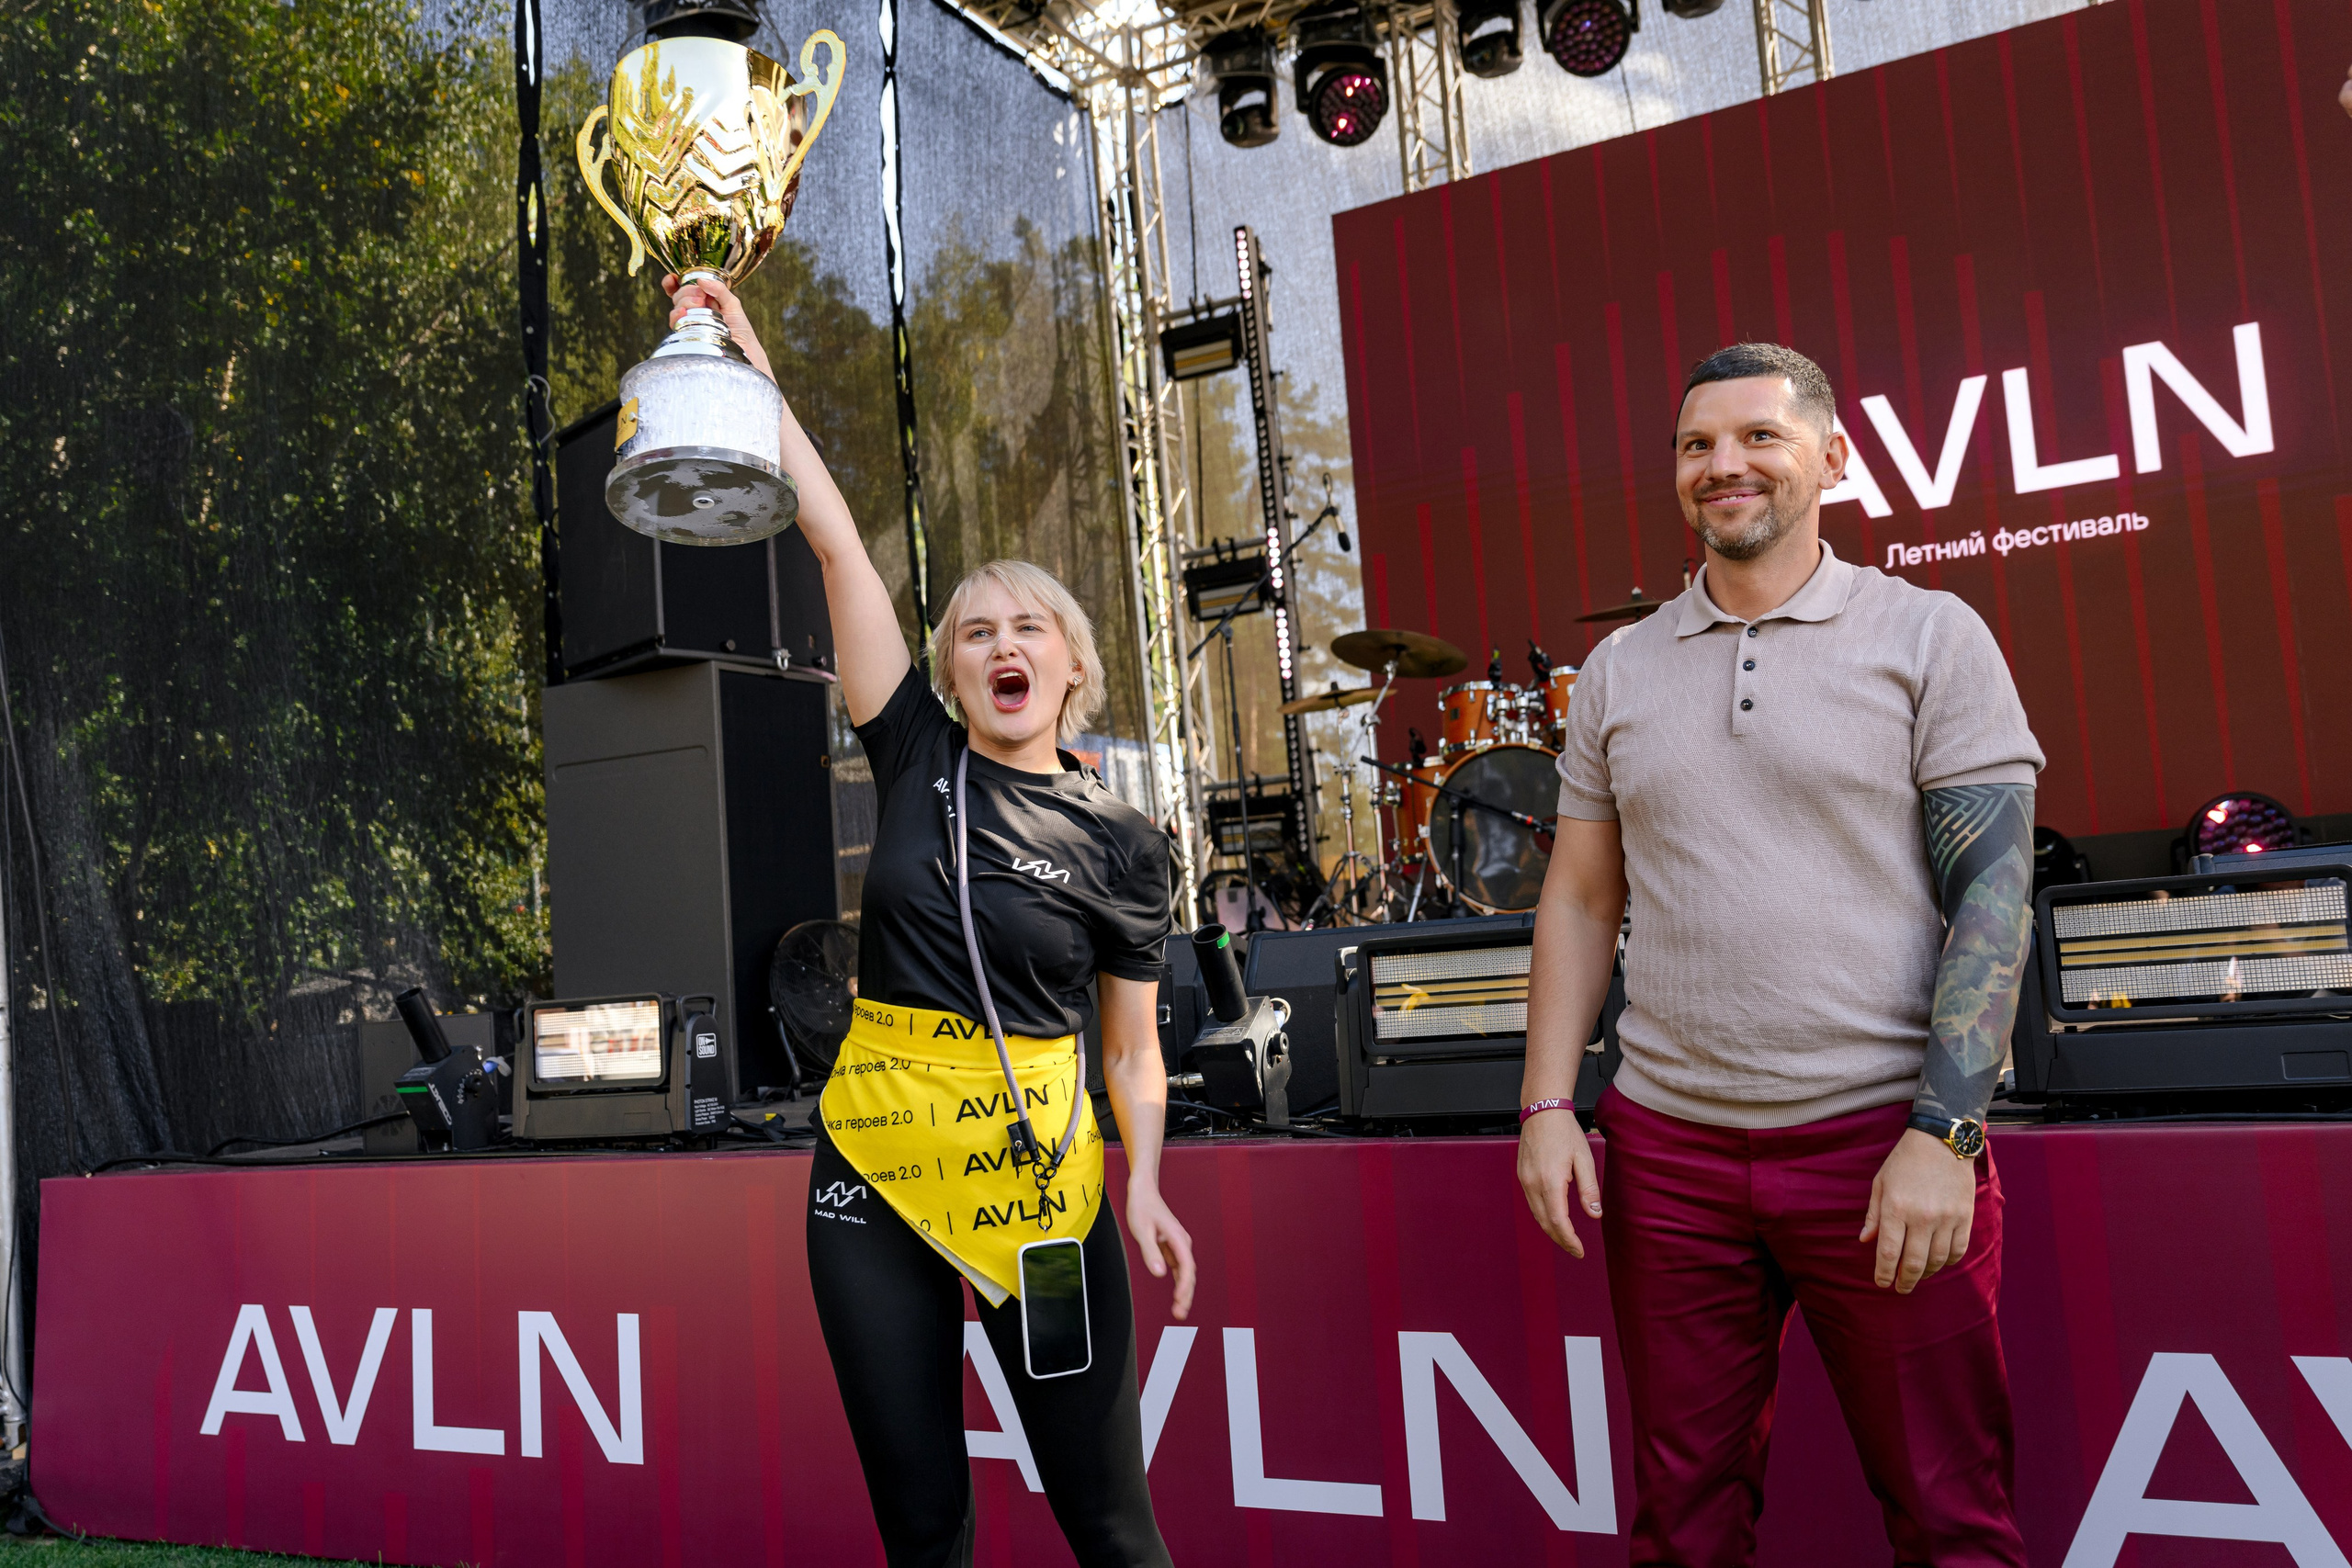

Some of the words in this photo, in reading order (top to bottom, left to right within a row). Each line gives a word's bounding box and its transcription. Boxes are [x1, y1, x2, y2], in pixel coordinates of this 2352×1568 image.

[1884, 529, 1985, 570] Летний
[1992, 512, 2150, 557] фестиваль
[876, 1010, 894, 1027] 2.0
[698, 1044, 715, 1055] SOUND
[849, 1060, 886, 1077] героев
[889, 1057, 910, 1070] 2.0
[956, 1084, 1049, 1122] AVLN
[1530, 1099, 1560, 1113] AVLN
[845, 1115, 888, 1132] героев
[891, 1110, 913, 1126] 2.0
[899, 1164, 922, 1180] 2.0
[814, 1209, 835, 1219] MAD
[840, 1213, 866, 1224] WILL
[199, 1303, 644, 1465] AVLN
